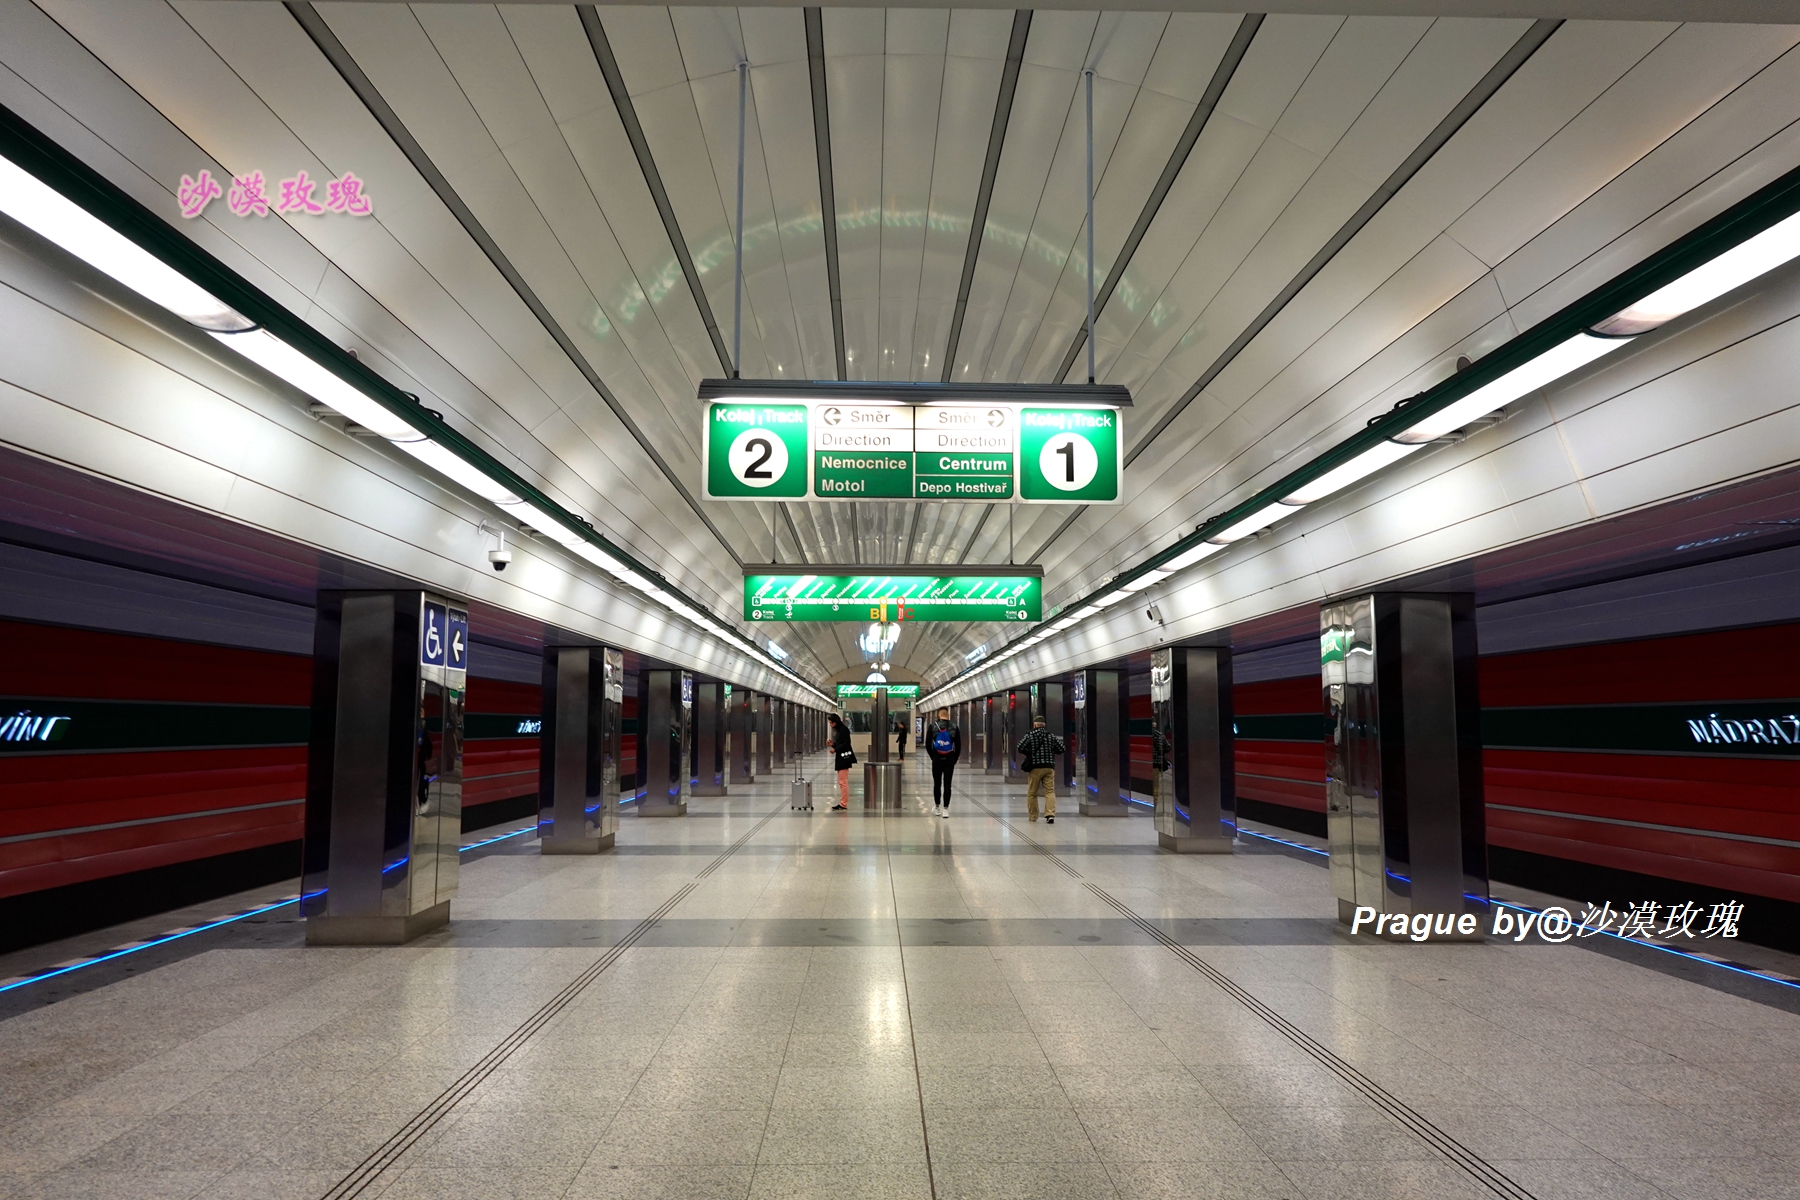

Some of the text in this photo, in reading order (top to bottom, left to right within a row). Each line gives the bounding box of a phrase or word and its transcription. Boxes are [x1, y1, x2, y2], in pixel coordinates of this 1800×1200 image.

[716, 408, 804, 425] Kolej Track
[850, 410, 891, 423] Směr
[938, 411, 977, 424] Směr
[1072, 413, 1112, 427] Track
[822, 433, 891, 446] Direction
[938, 434, 1006, 447] Direction
[744, 438, 773, 479] 2
[822, 456, 907, 469] Nemocnice
[939, 457, 1007, 470] Centrum
[1056, 442, 1075, 482] 1
[822, 479, 865, 492] Motol
[920, 482, 1007, 495] Depo Hostivař
[870, 608, 880, 619] B
[905, 608, 915, 619] C
